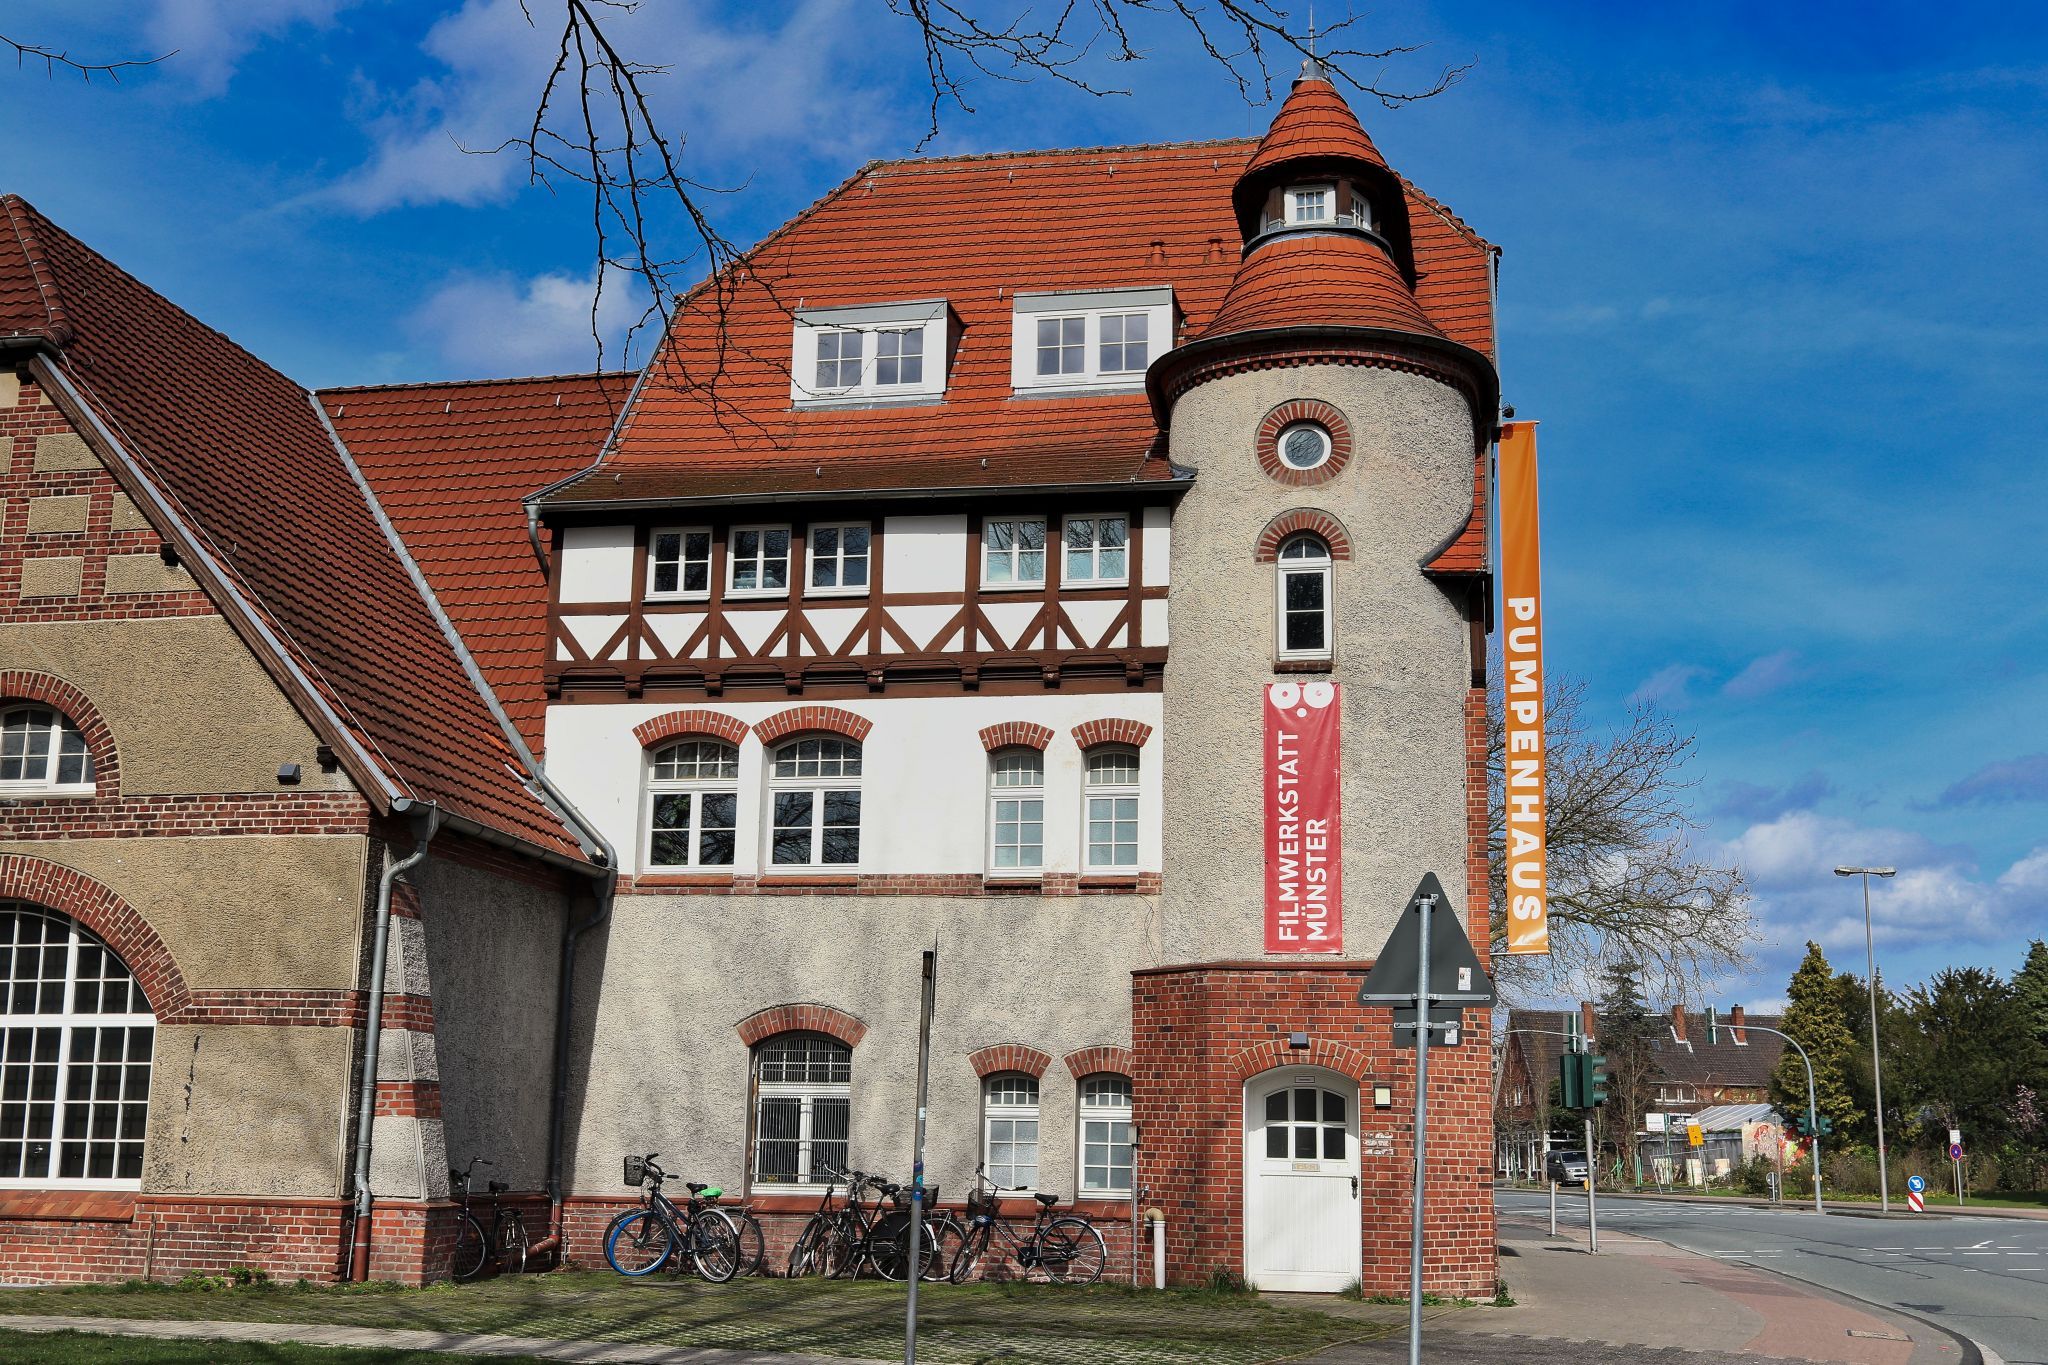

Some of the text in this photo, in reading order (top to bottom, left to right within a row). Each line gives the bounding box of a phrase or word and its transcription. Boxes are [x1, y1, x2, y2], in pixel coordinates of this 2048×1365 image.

[1278, 730, 1299, 941] FILMWERKSTATT
[1508, 597, 1541, 920] PUMPENHAUS
[1301, 818, 1328, 941] MÜNSTER
